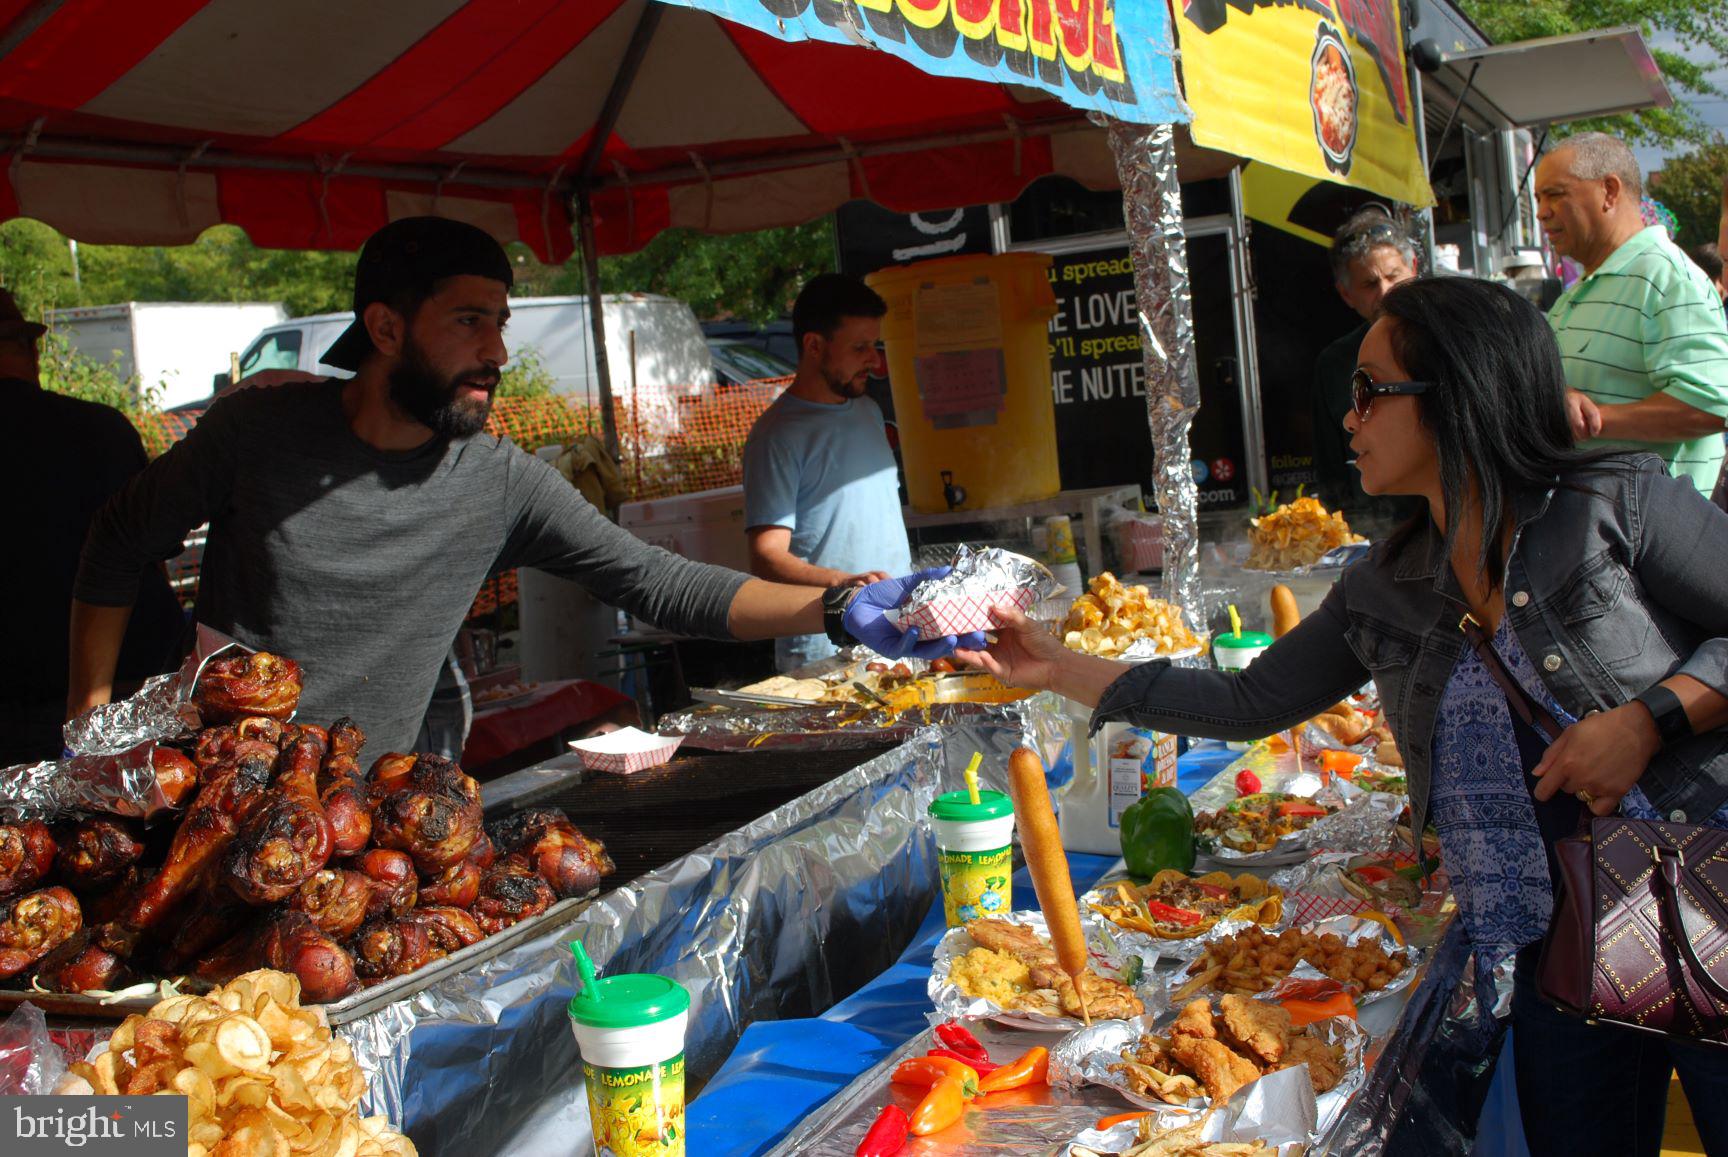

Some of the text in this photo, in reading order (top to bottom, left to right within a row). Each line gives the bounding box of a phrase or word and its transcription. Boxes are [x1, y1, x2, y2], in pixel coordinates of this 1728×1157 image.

[1063, 256, 1134, 285] spread
[1074, 290, 1138, 330] LOVE
[1272, 455, 1313, 470] follow
[602, 1066, 667, 1088] LEMONAE
